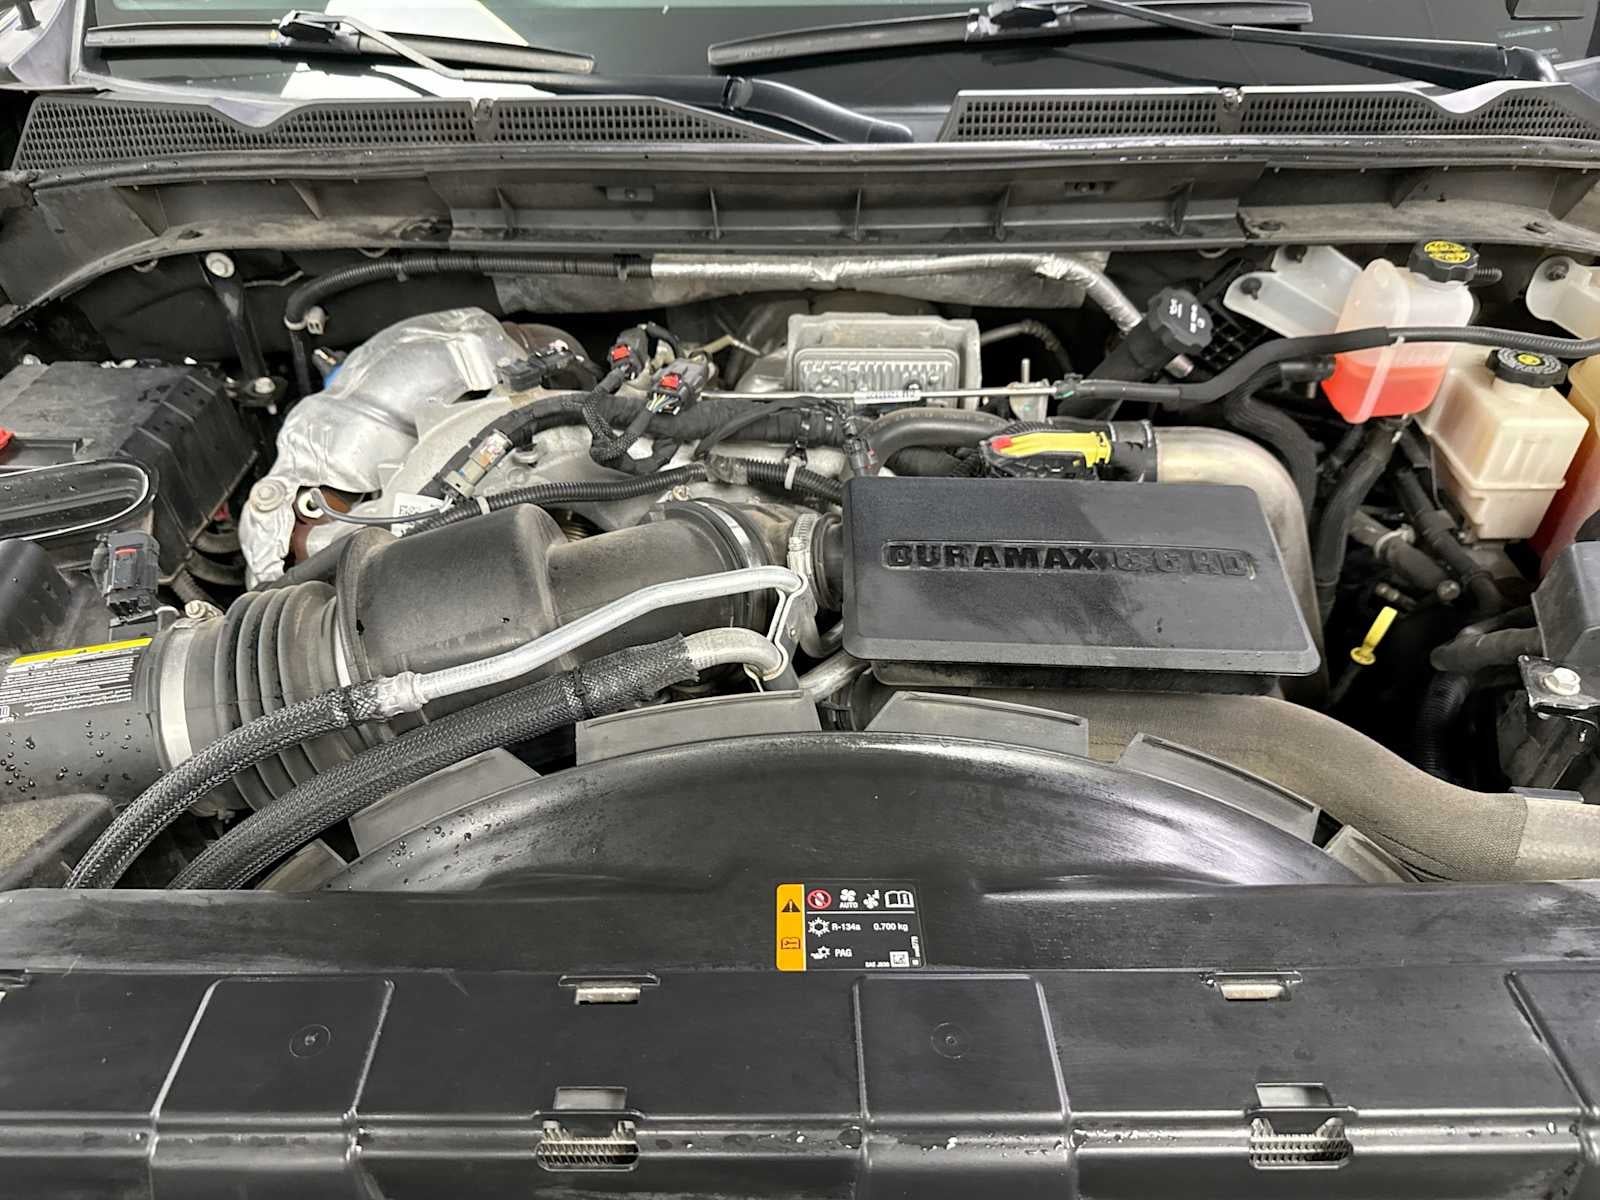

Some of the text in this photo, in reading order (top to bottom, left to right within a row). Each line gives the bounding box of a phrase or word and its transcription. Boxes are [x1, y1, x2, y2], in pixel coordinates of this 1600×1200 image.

[887, 543, 1098, 571] DURAMAX
[839, 901, 858, 909] AUTO
[831, 923, 909, 932] R-134a 0.700 kg
[834, 948, 853, 957] PAG
